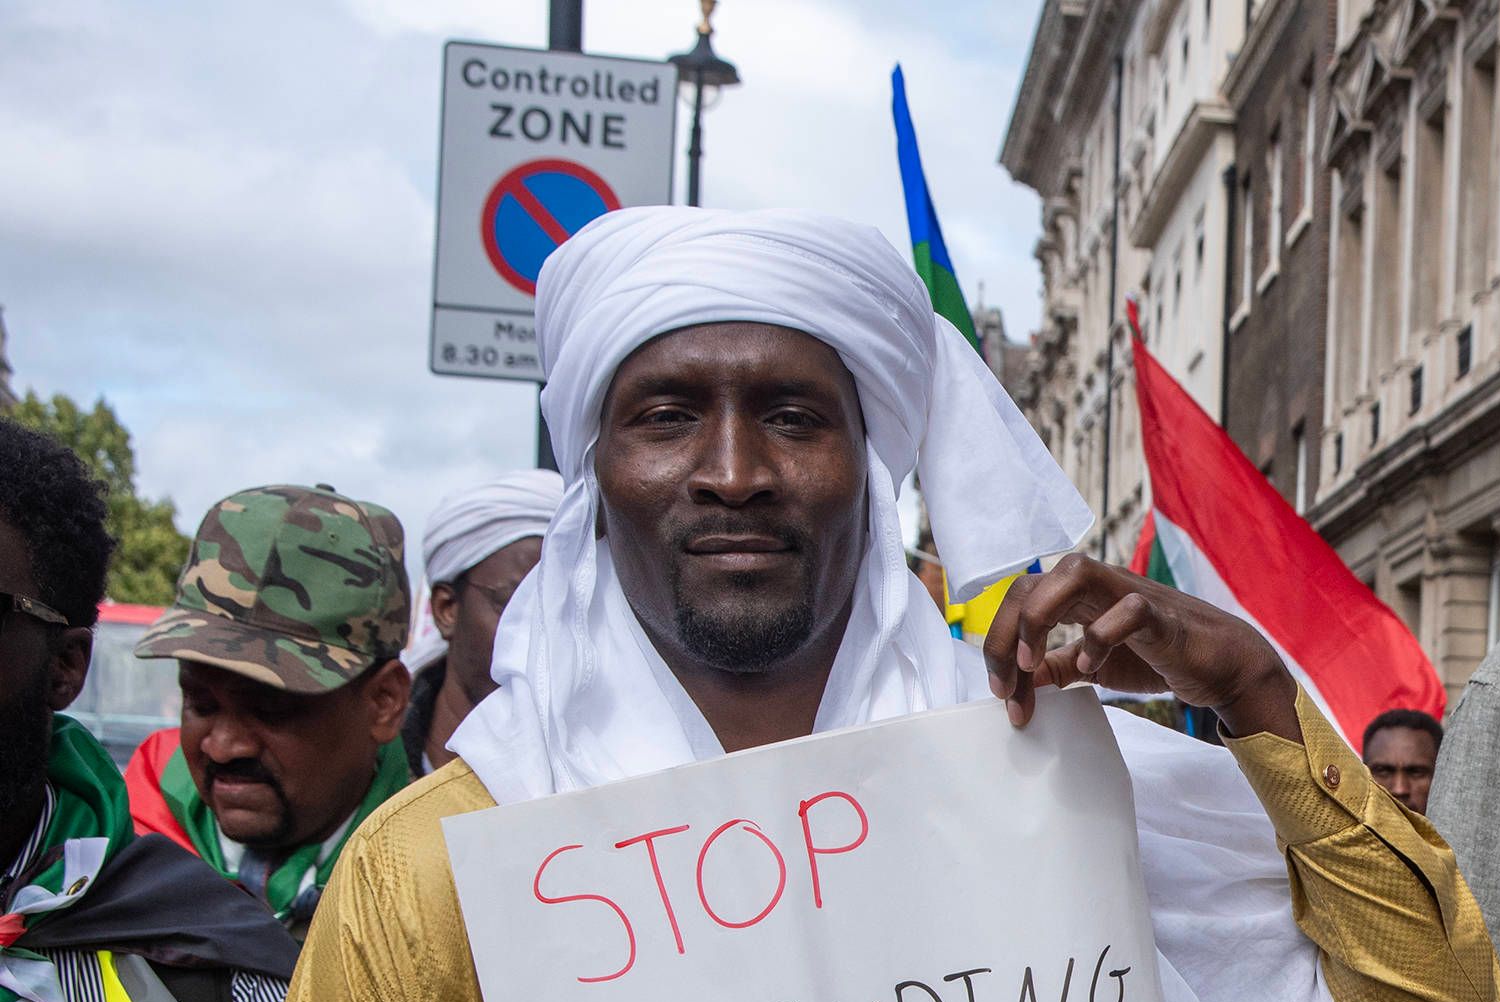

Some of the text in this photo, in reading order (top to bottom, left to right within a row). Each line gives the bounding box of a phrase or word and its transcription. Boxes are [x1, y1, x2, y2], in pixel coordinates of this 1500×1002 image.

[462, 58, 660, 105] Controlled
[488, 103, 627, 150] ZONE
[532, 790, 870, 983] STOP
